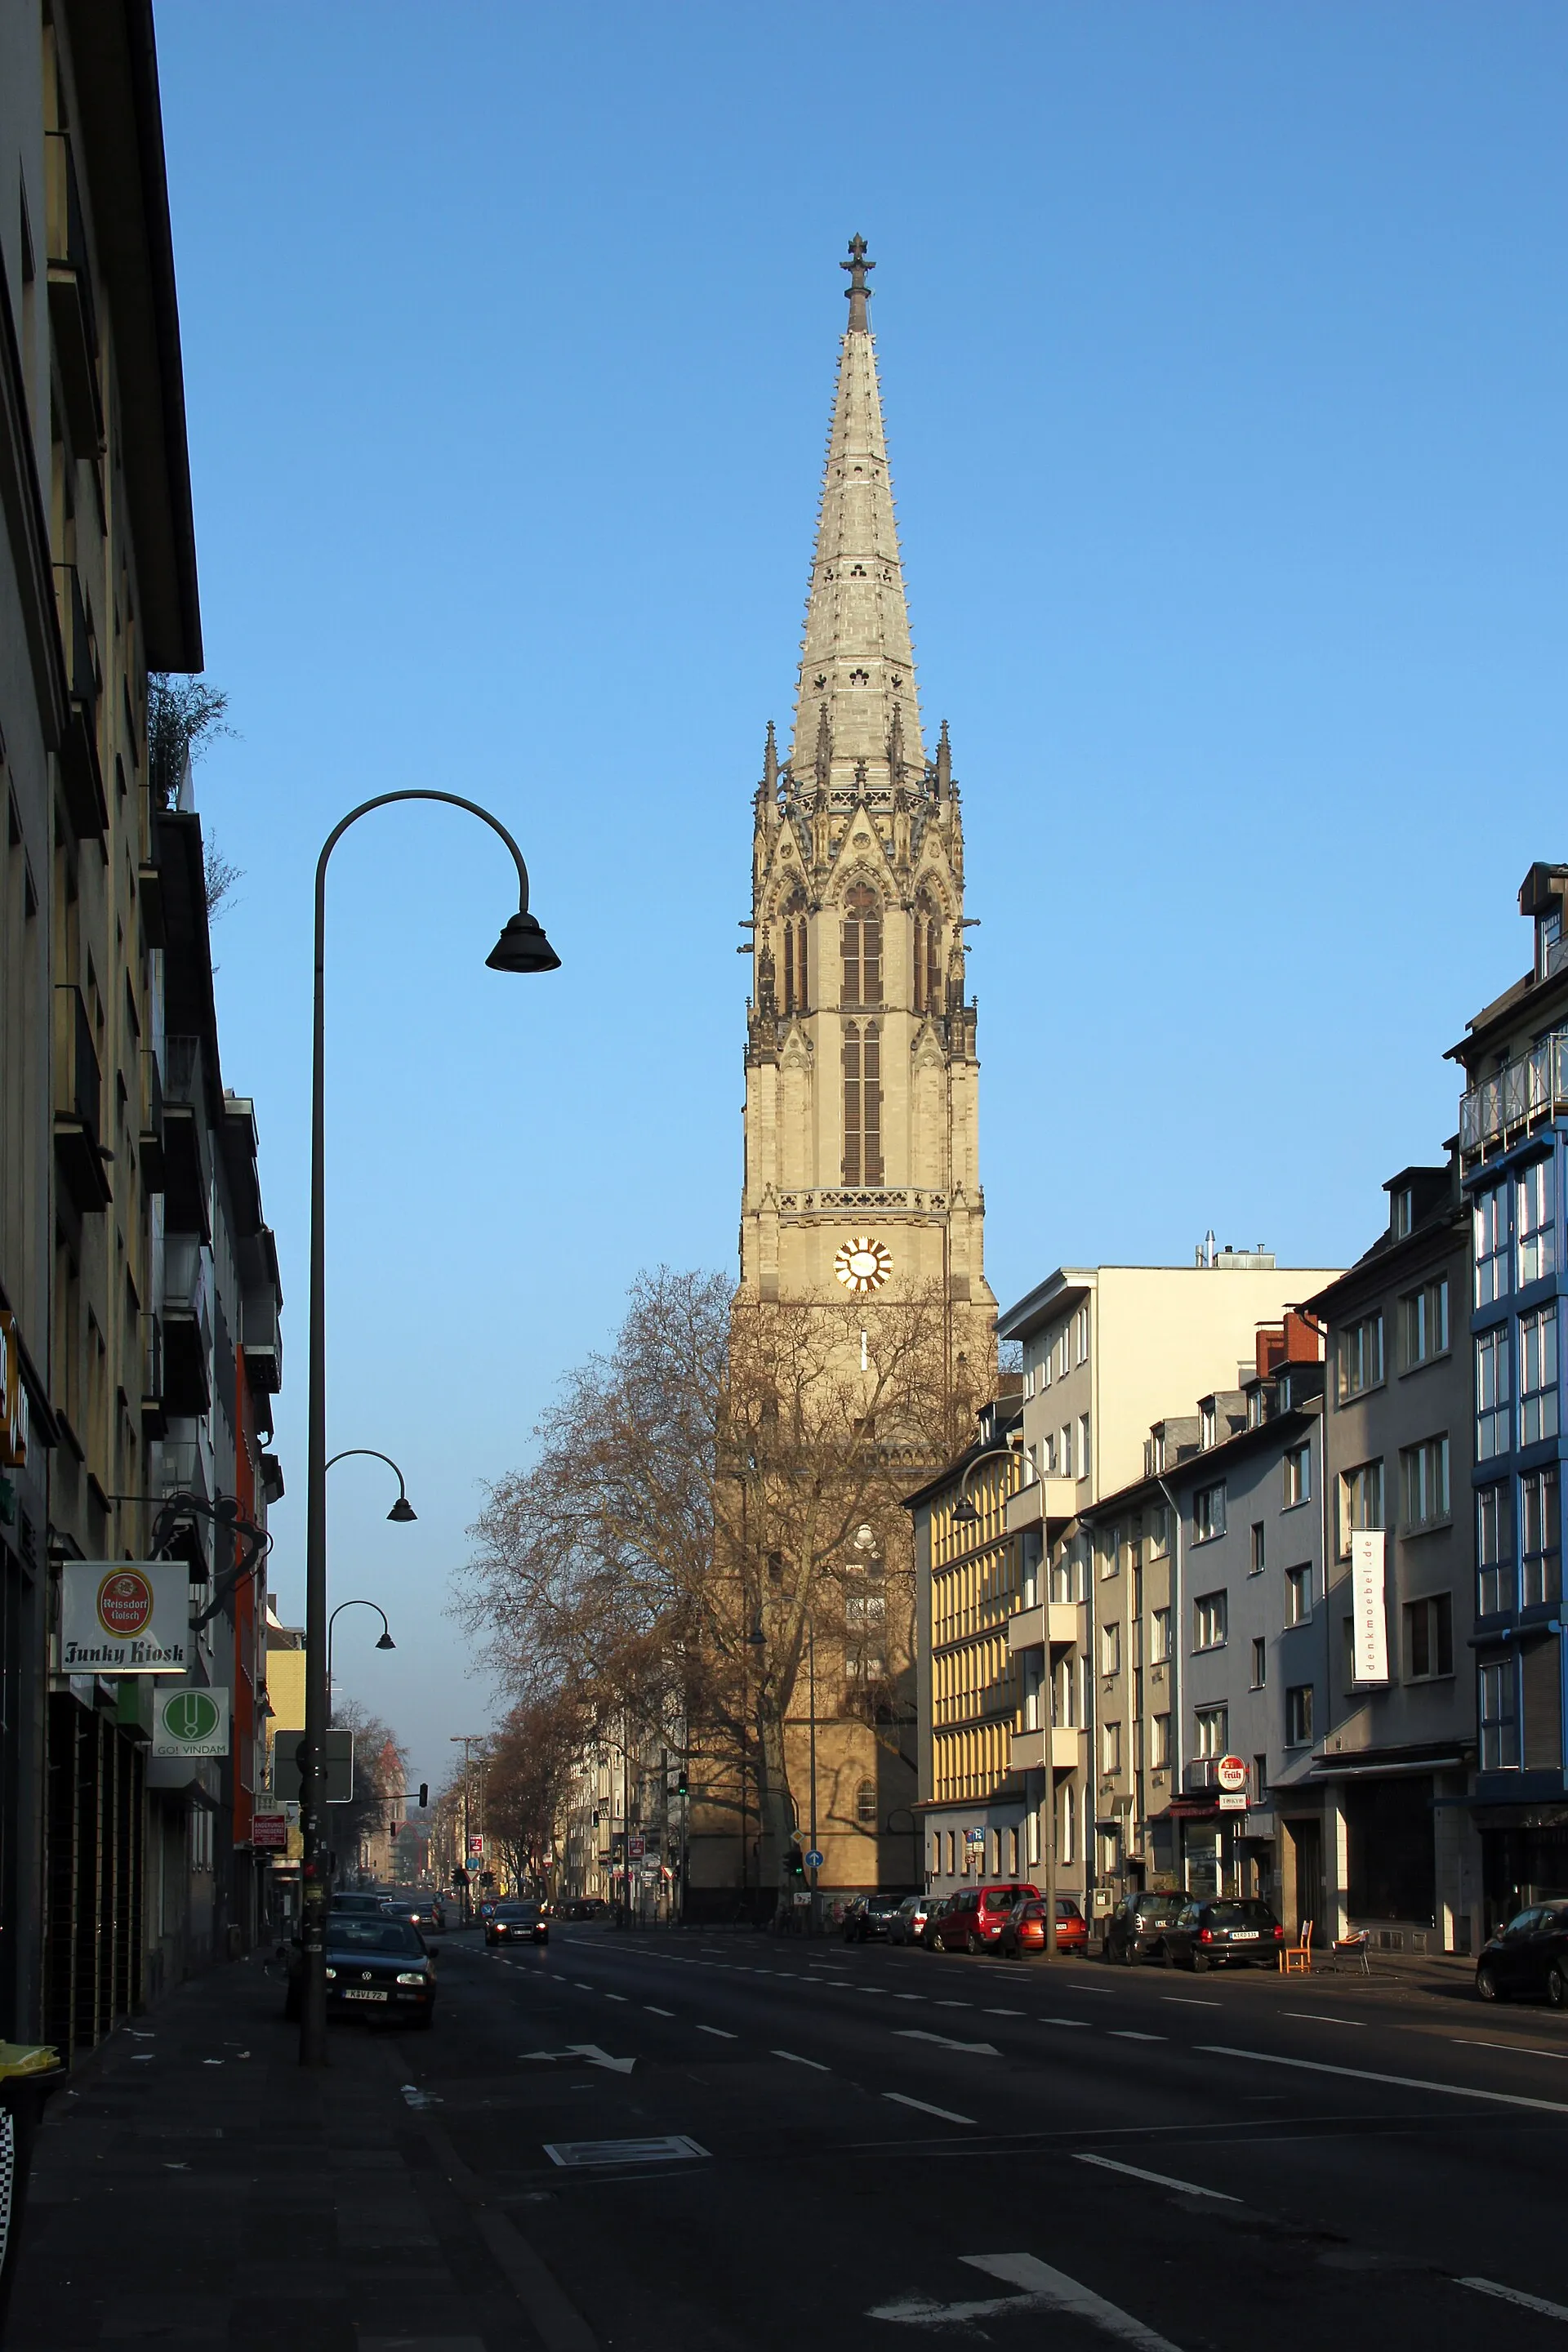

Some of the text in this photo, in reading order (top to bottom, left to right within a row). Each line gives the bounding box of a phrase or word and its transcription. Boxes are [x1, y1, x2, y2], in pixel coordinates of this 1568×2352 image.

[103, 1598, 148, 1609] Reissdorf
[1363, 1541, 1375, 1670] denkmoebel.de
[65, 1641, 184, 1664] Funky Kiosk
[158, 1745, 225, 1754] GO! VINDAM
